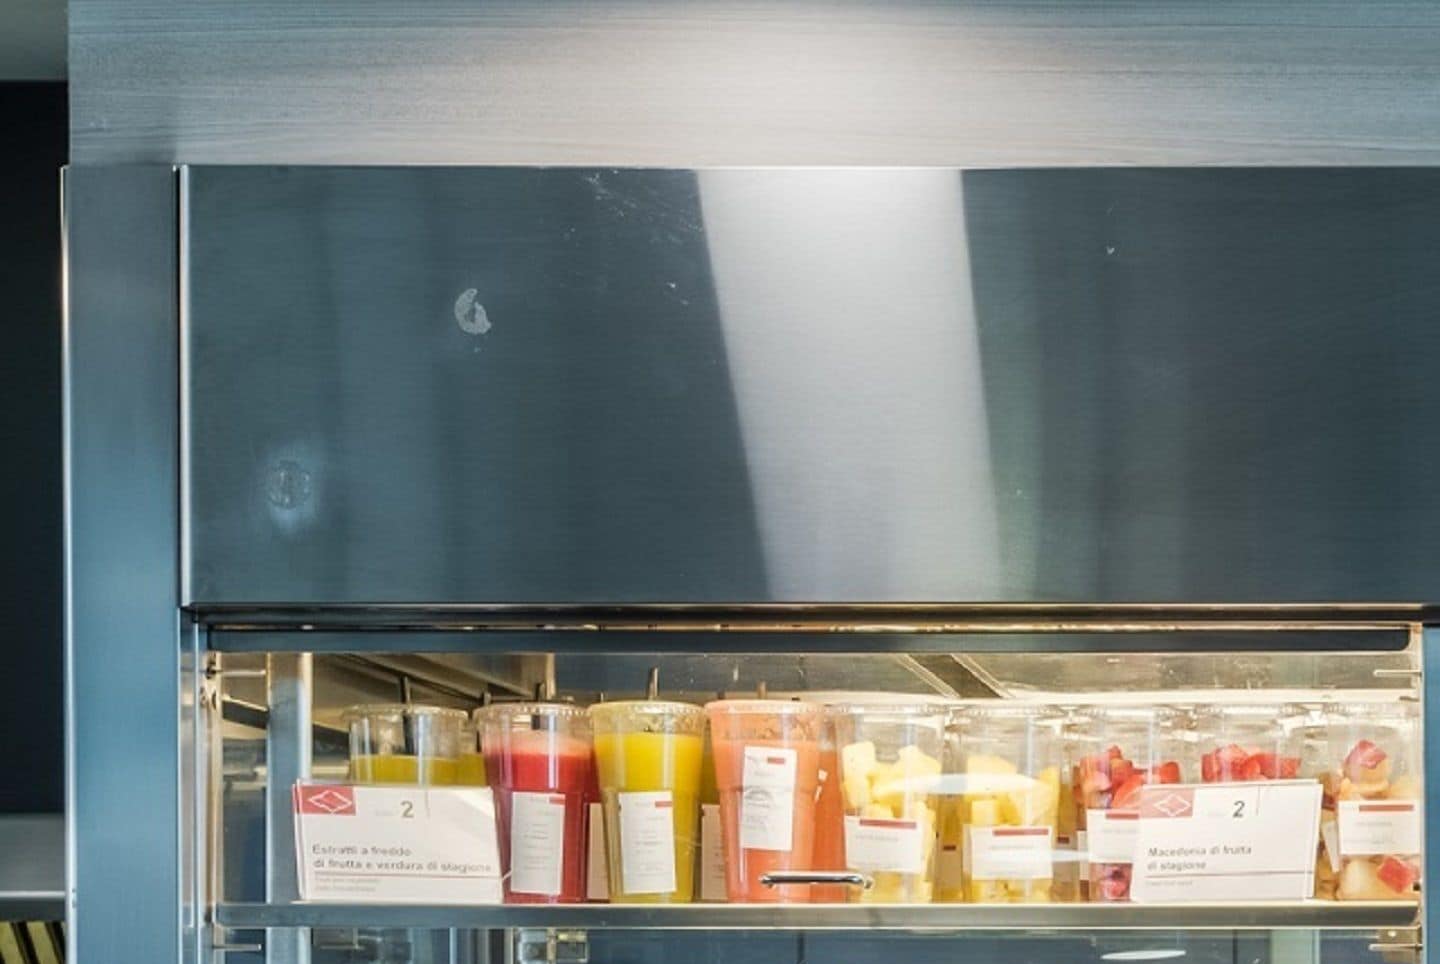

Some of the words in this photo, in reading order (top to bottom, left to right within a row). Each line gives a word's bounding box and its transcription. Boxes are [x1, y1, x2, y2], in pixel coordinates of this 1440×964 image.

[401, 801, 414, 818] 2
[1232, 801, 1245, 818] 2
[312, 844, 357, 855] Estratti
[371, 845, 411, 856] freddo
[1148, 847, 1206, 857] Macedonia
[1210, 846, 1220, 855] di
[313, 860, 324, 868] di
[328, 859, 362, 869] frutta
[376, 861, 423, 871] verdura
[426, 861, 437, 871] di
[440, 862, 491, 874] stagione
[1148, 861, 1156, 870] di
[1160, 861, 1206, 872] stagione
